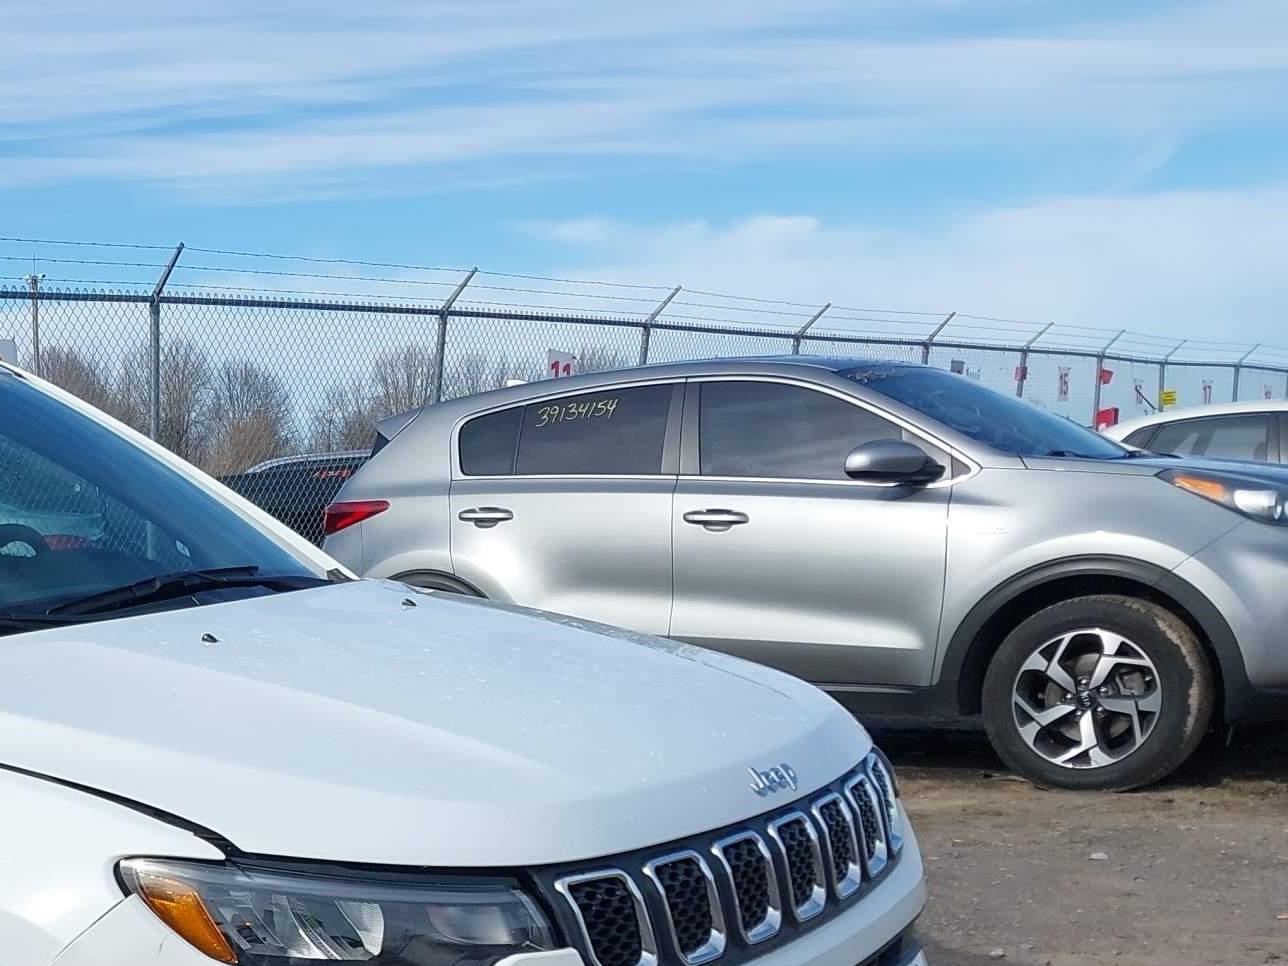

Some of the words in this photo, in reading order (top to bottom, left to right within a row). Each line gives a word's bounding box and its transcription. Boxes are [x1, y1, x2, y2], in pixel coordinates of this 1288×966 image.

[550, 360, 572, 377] 11
[536, 399, 618, 427] 39134154
[745, 764, 798, 797] Jeep
